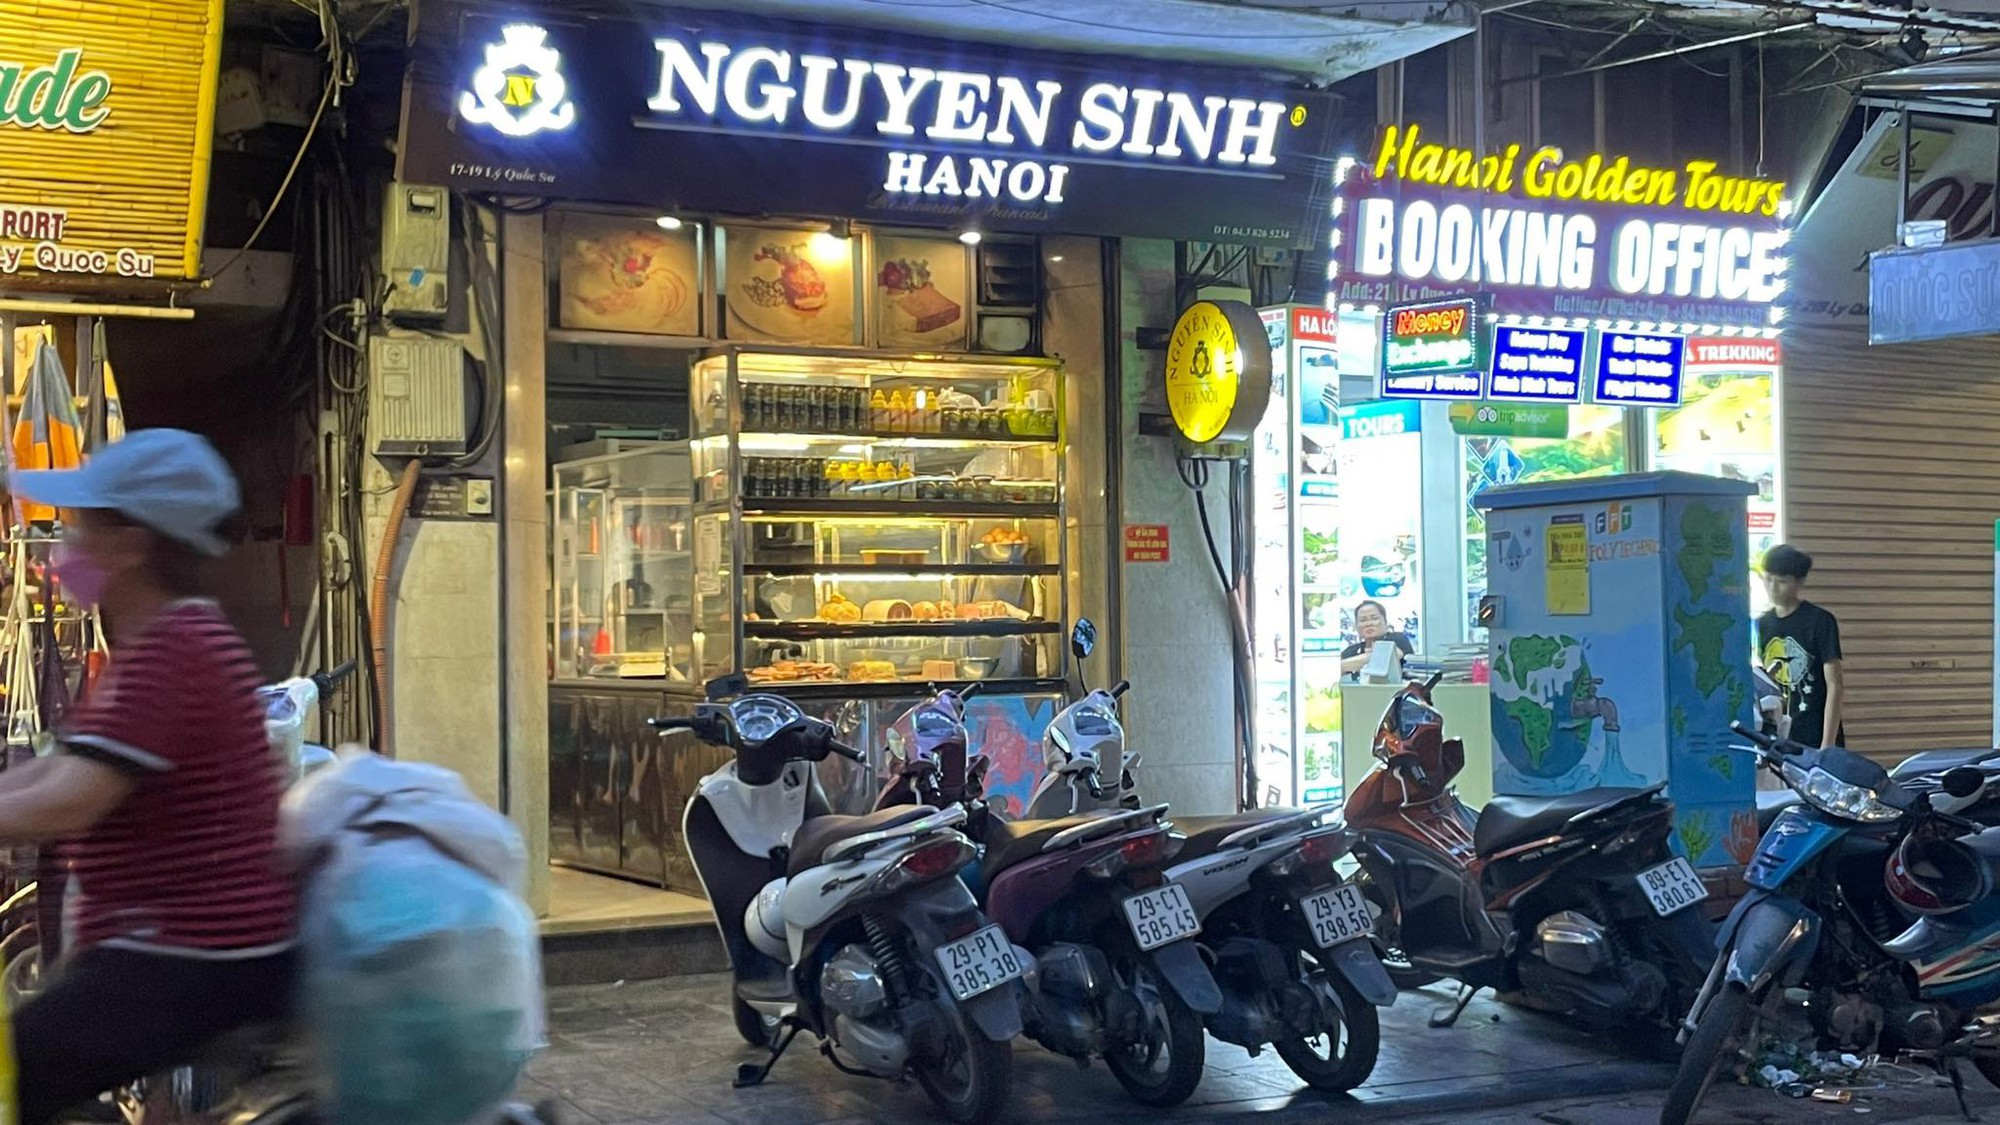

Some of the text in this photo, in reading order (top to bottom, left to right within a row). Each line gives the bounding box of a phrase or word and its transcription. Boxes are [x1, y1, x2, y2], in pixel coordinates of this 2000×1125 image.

[647, 38, 1287, 166] NGUYEN SINH
[883, 151, 1069, 203] HANOI
[1379, 122, 1786, 217] Hanoi Golden Tours
[0, 245, 154, 275] y Quoc Su
[1355, 198, 1791, 303] BOOKING OFFICE
[1340, 281, 1374, 301] Add:
[1375, 283, 1391, 301] 21
[1299, 314, 1320, 334] HA
[1396, 308, 1465, 336] Money
[1697, 344, 1775, 363] TREKKING
[1348, 414, 1405, 438] TOURS
[1499, 409, 1550, 426] tripadvisor
[1645, 860, 1689, 891] 89-E1
[1133, 887, 1182, 920] 29-C1
[1311, 888, 1356, 919] 29-Y3
[1653, 878, 1705, 912] 380.61
[1137, 908, 1197, 945] 585.45
[1316, 909, 1371, 944] 298.56
[946, 931, 1000, 970] 29-P1
[952, 952, 1018, 995] 385.38
